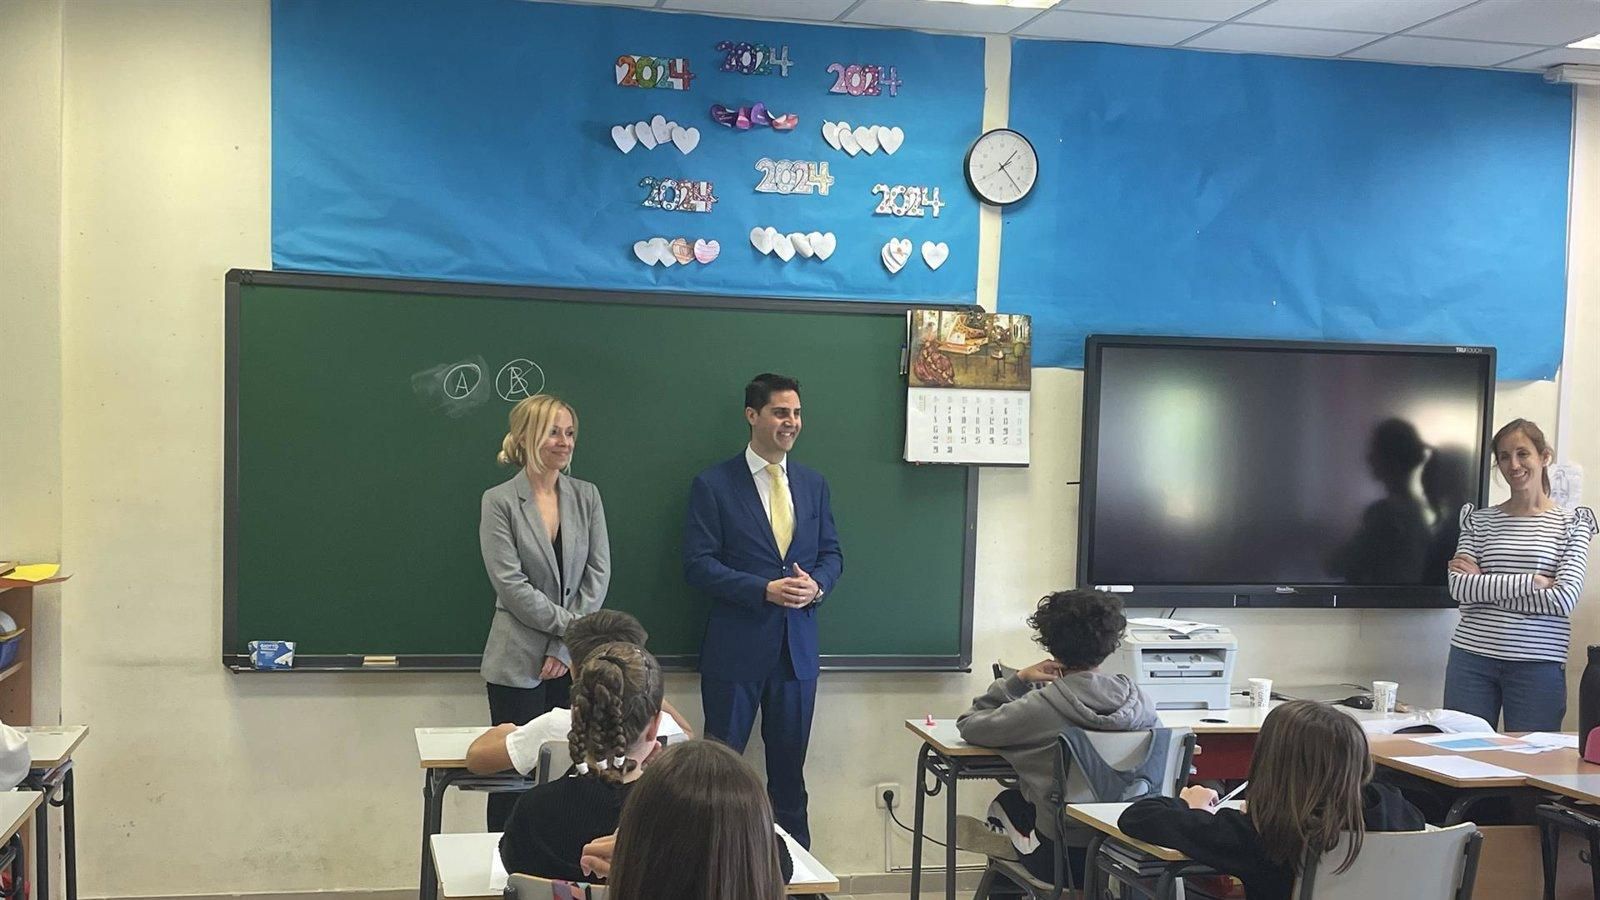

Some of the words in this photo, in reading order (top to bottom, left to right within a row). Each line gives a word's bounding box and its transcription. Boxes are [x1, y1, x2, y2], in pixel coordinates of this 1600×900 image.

[615, 54, 696, 91] 2024
[717, 41, 794, 77] 2024
[826, 62, 902, 97] 2024
[755, 158, 834, 195] 2024
[640, 177, 719, 213] 2024
[872, 183, 945, 218] 2024
